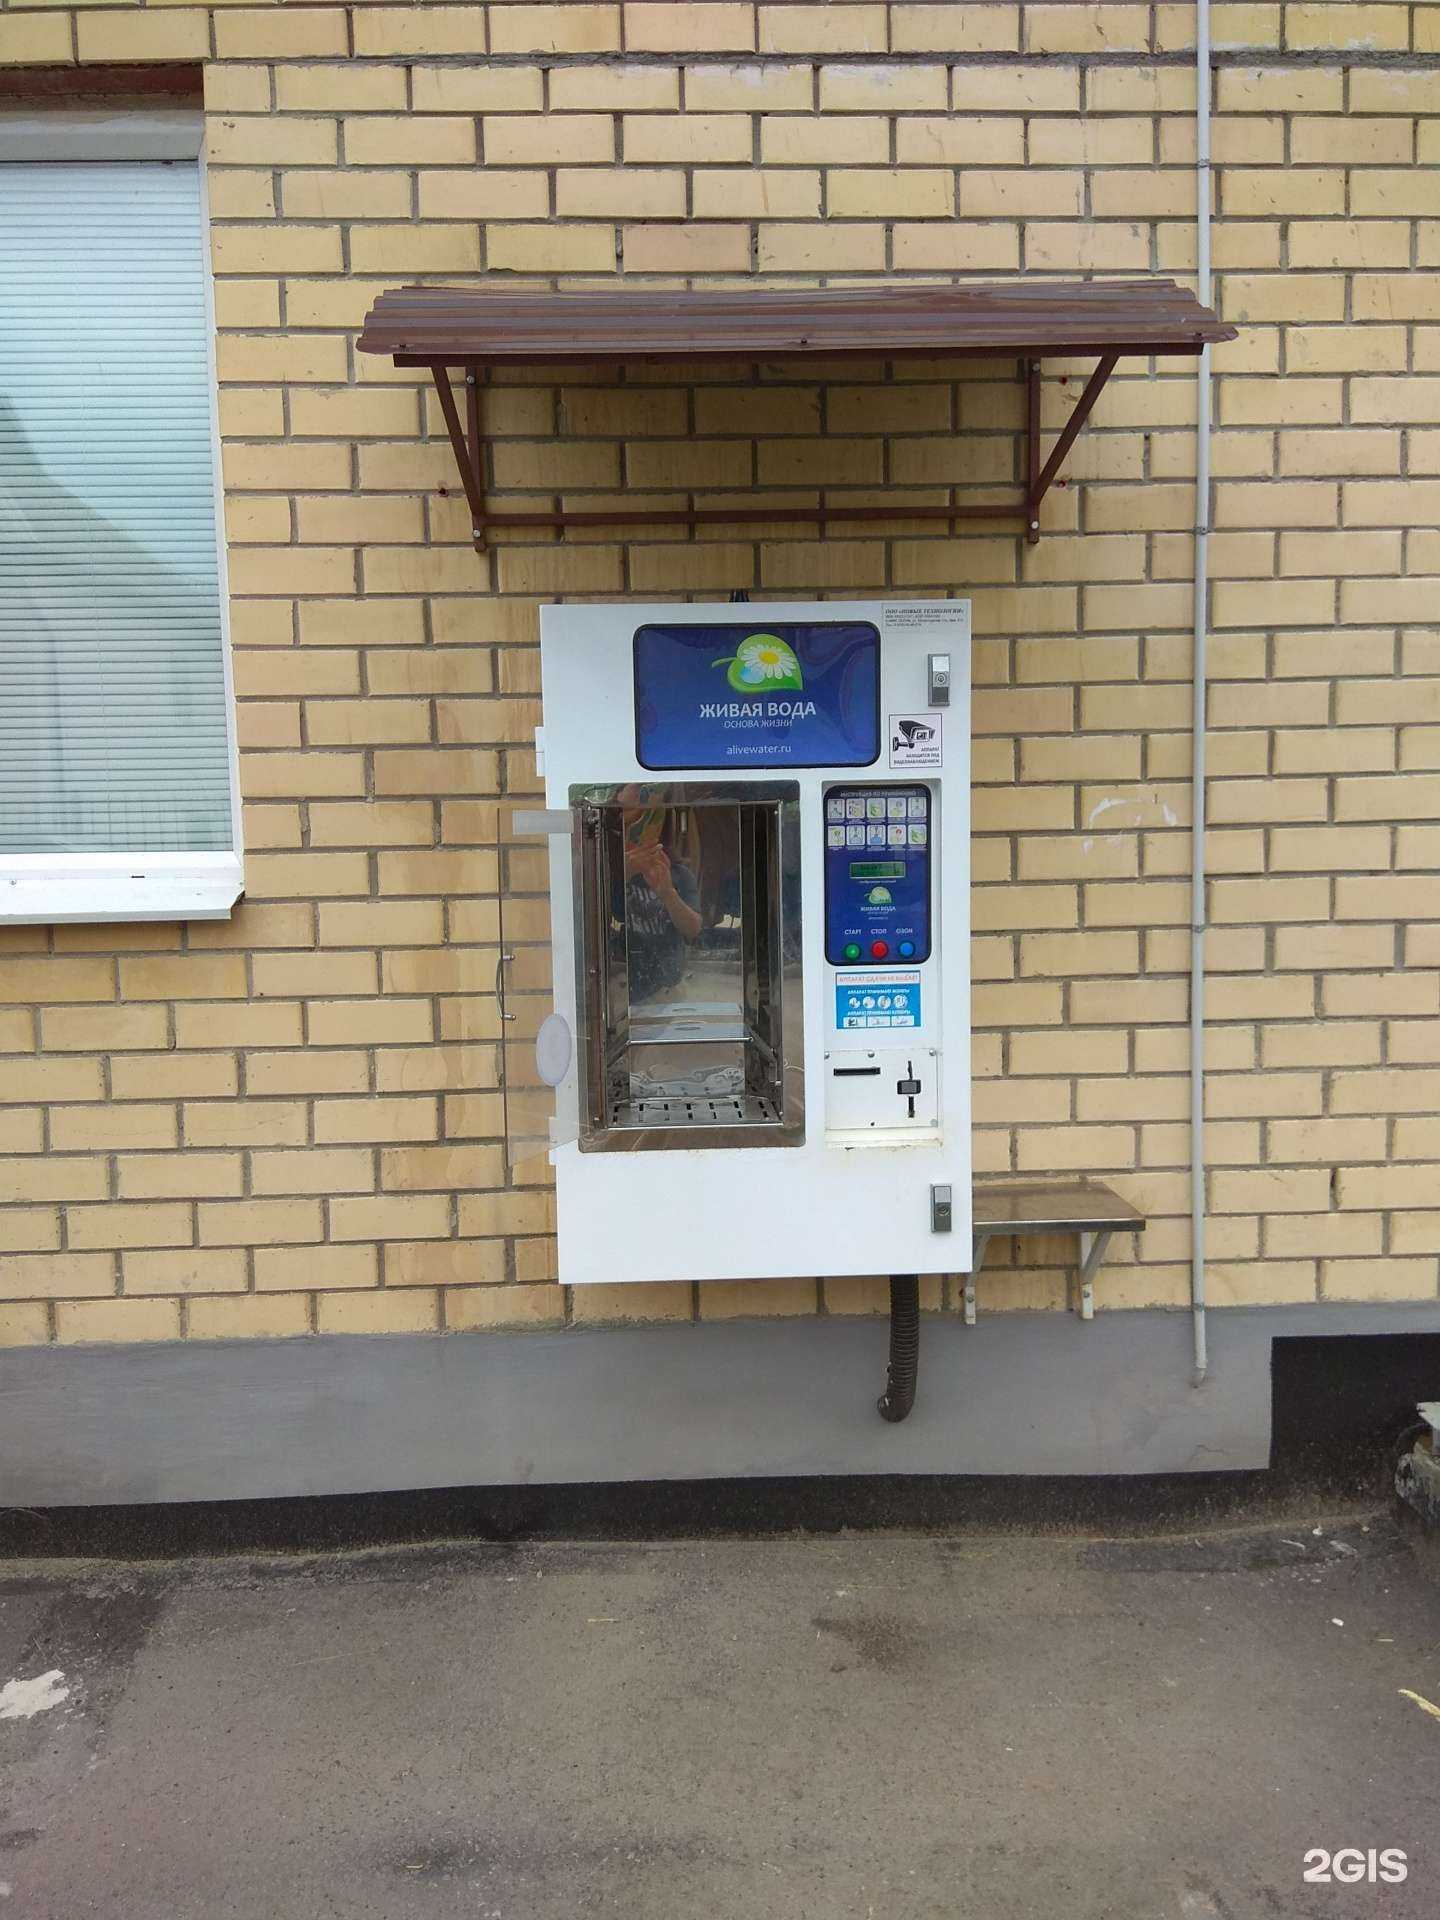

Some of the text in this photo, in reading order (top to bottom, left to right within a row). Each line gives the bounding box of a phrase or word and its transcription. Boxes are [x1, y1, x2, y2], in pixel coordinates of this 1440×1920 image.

[699, 701, 817, 720] ЖИВАЯ ВОДА
[724, 719, 793, 729] ОСНОВА ЖИЗНИ
[726, 744, 792, 755] alivewater.ru
